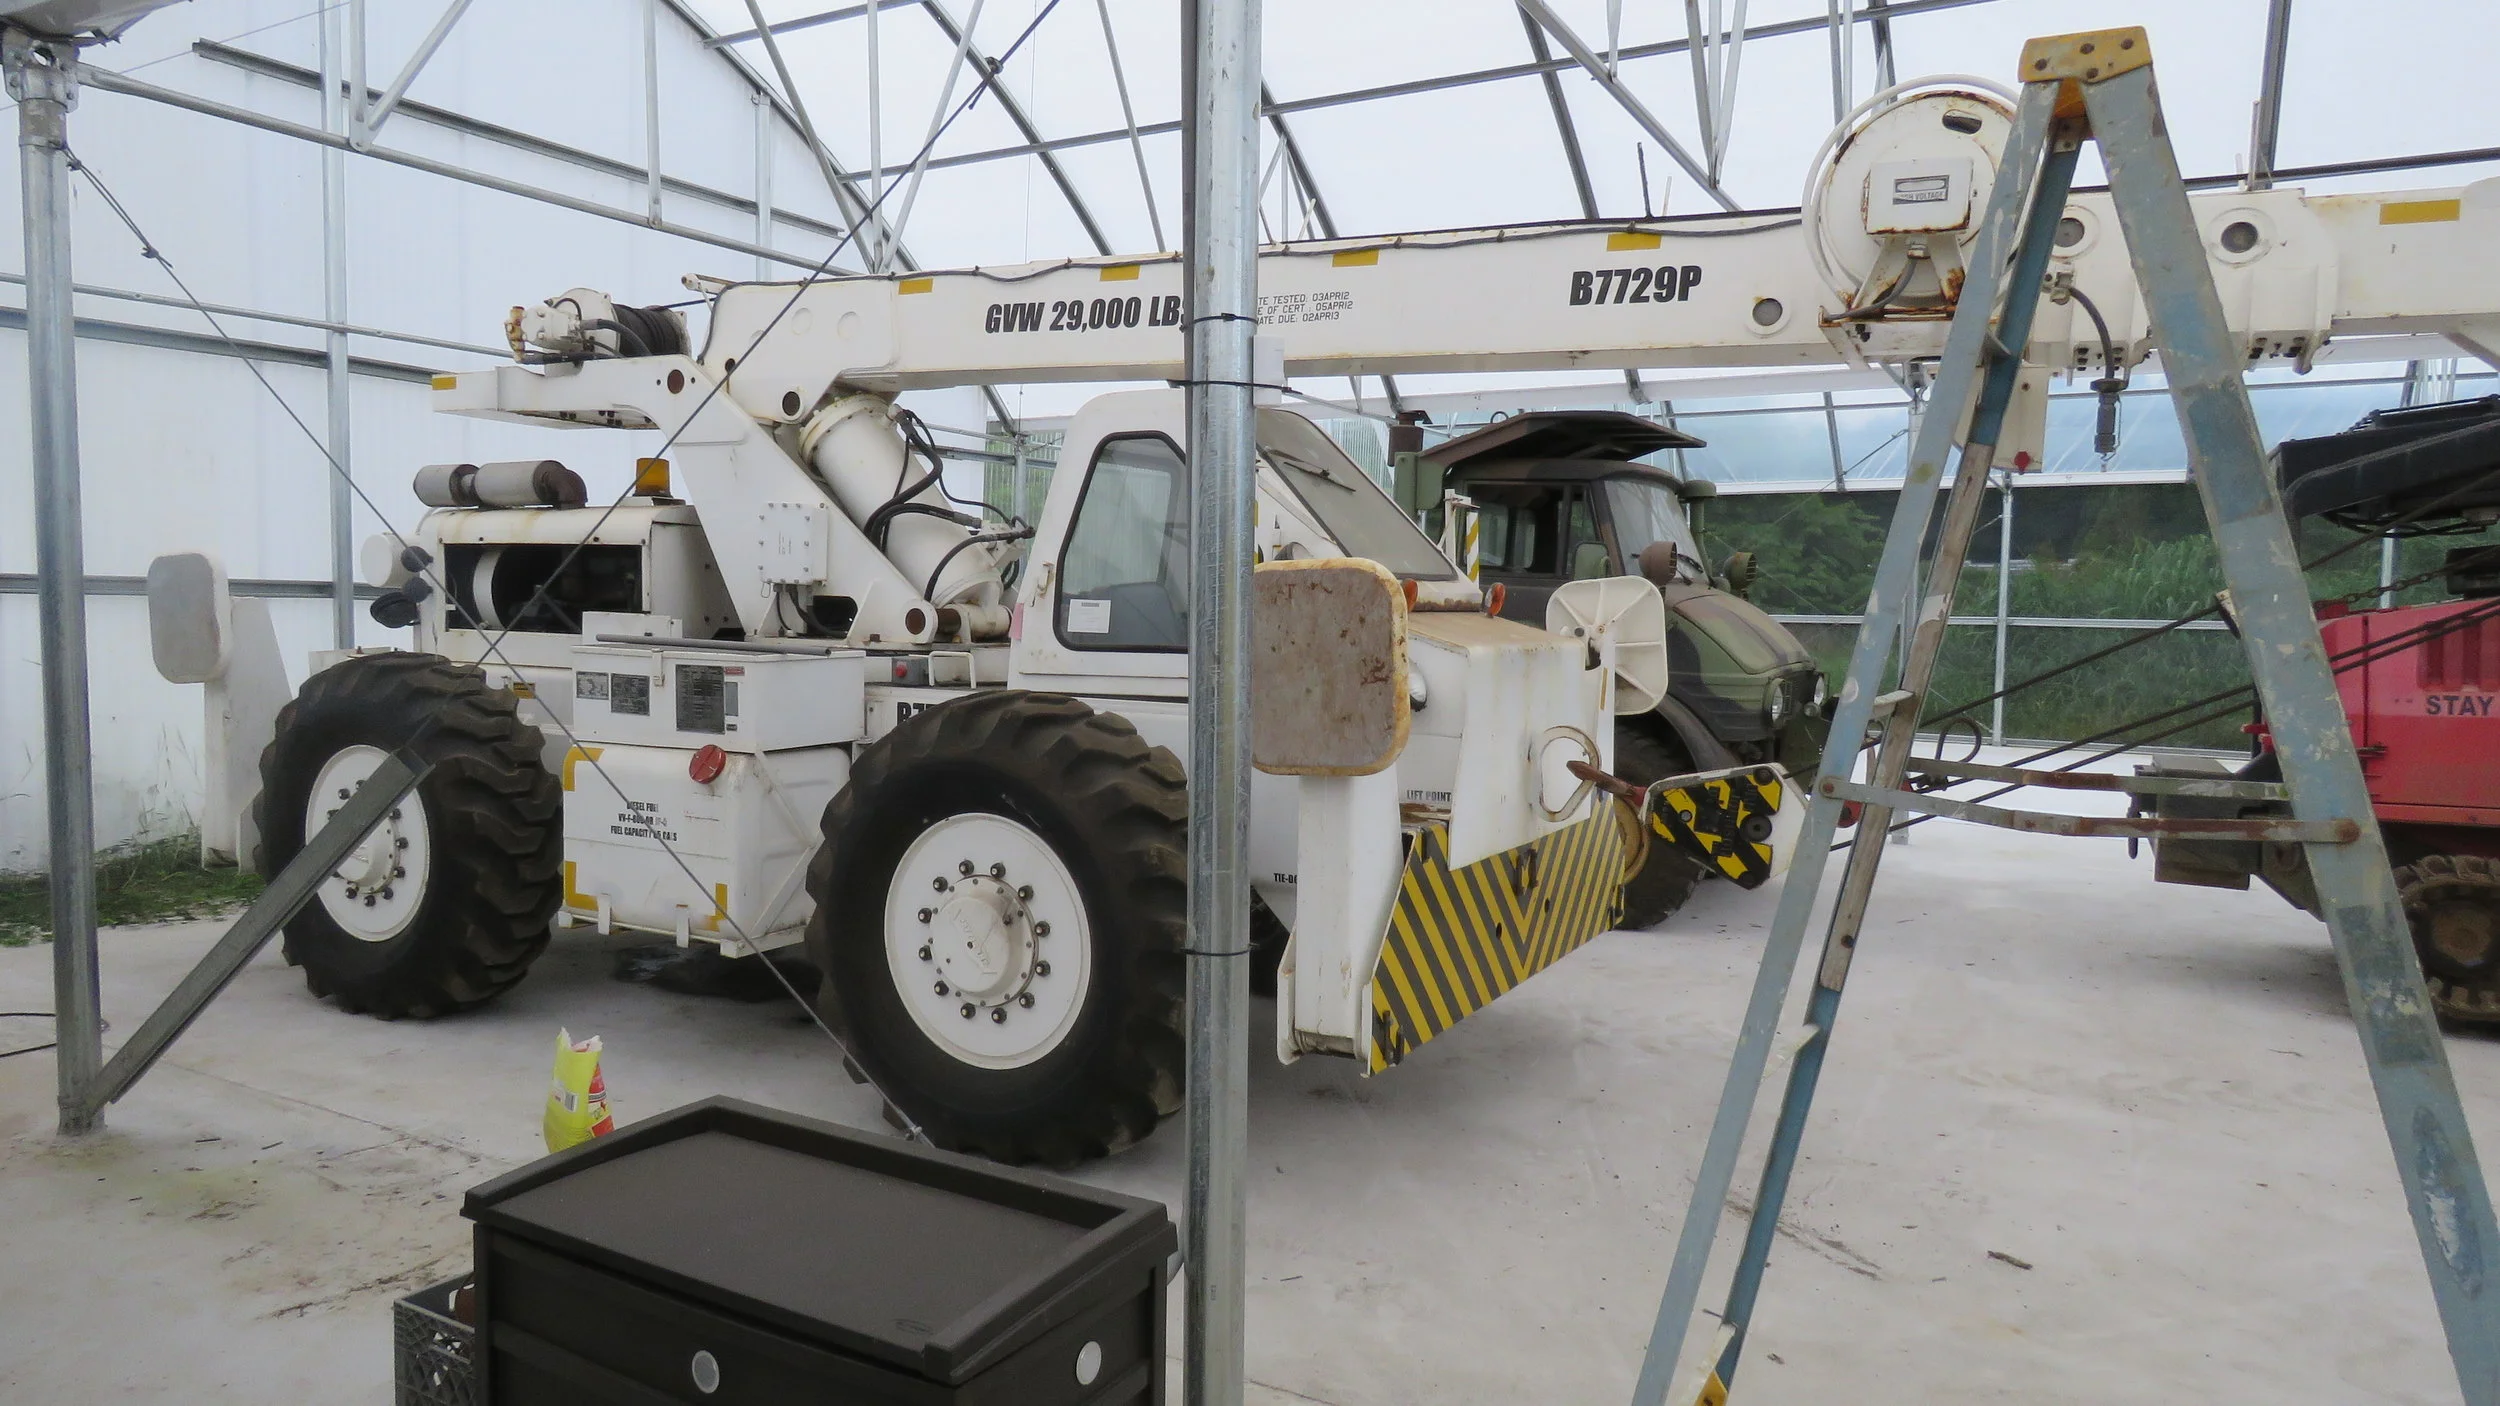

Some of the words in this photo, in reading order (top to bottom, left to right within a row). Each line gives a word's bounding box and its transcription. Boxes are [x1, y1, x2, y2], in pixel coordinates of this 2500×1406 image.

[1569, 265, 1702, 306] B7729P
[1312, 291, 1350, 302] 03APR12
[985, 303, 1045, 334] GVW
[1049, 296, 1141, 333] 29,000
[1148, 295, 1183, 327] LB
[1267, 305, 1279, 315] OF
[1315, 300, 1353, 311] 05APR12
[1257, 315, 1274, 325] ATE
[1302, 311, 1340, 322] 02APR13
[2425, 695, 2495, 716] STAY
[1406, 790, 1423, 801] LIFT
[611, 825, 623, 835] FUEL
